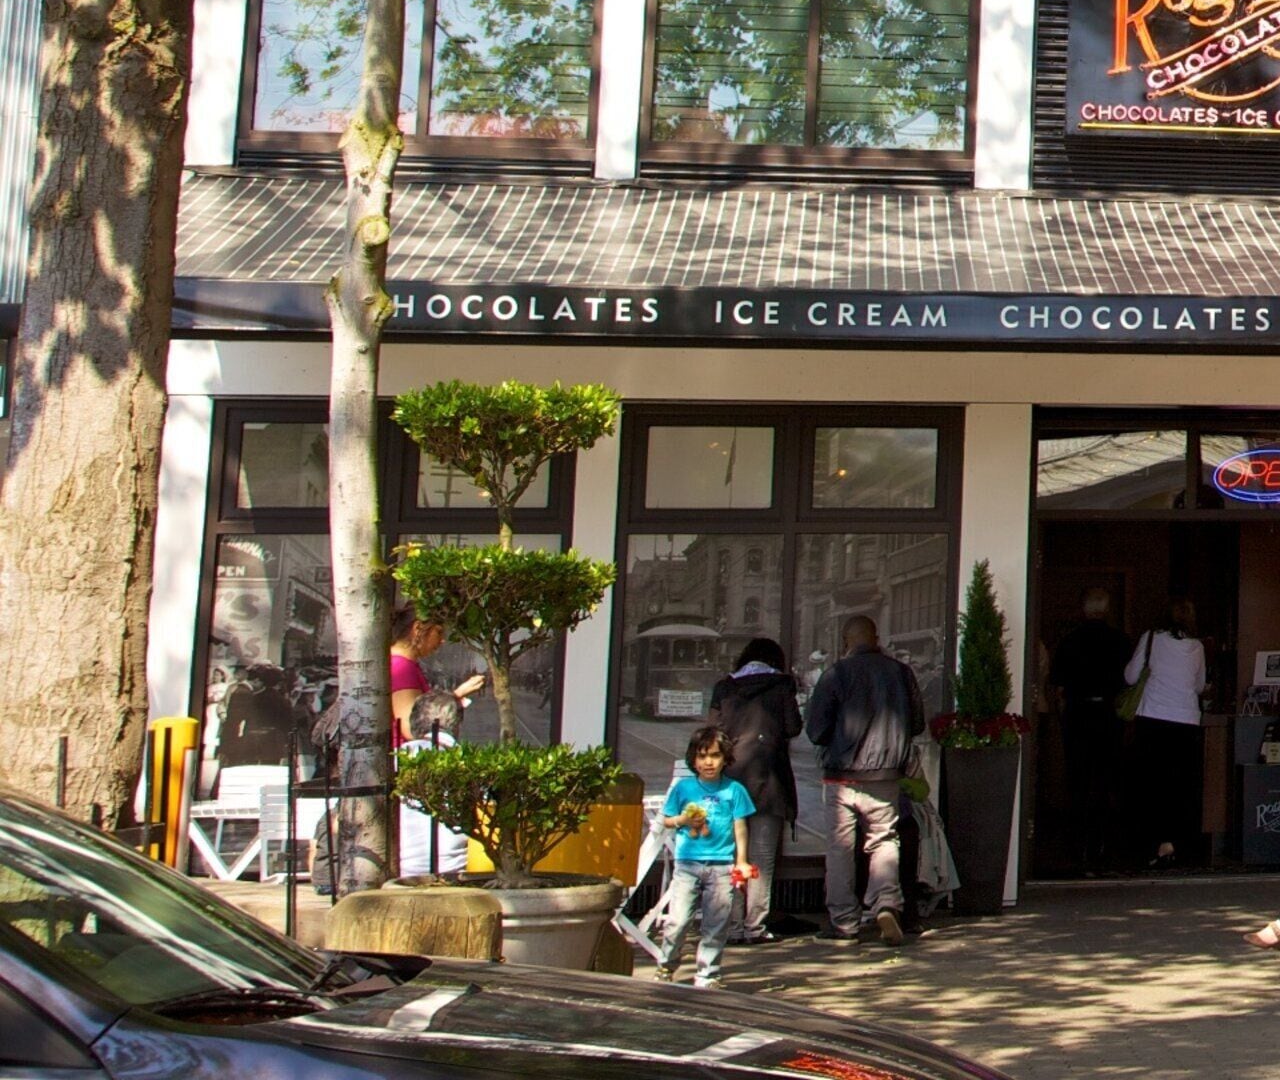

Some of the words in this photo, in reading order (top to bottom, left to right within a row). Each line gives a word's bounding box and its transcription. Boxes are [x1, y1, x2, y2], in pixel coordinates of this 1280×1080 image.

[1081, 103, 1218, 124] CHOCOLATES
[392, 294, 657, 322] HOCOLATES
[714, 299, 779, 325] ICE
[807, 302, 948, 328] CREAM
[1000, 305, 1271, 332] CHOCOLATES
